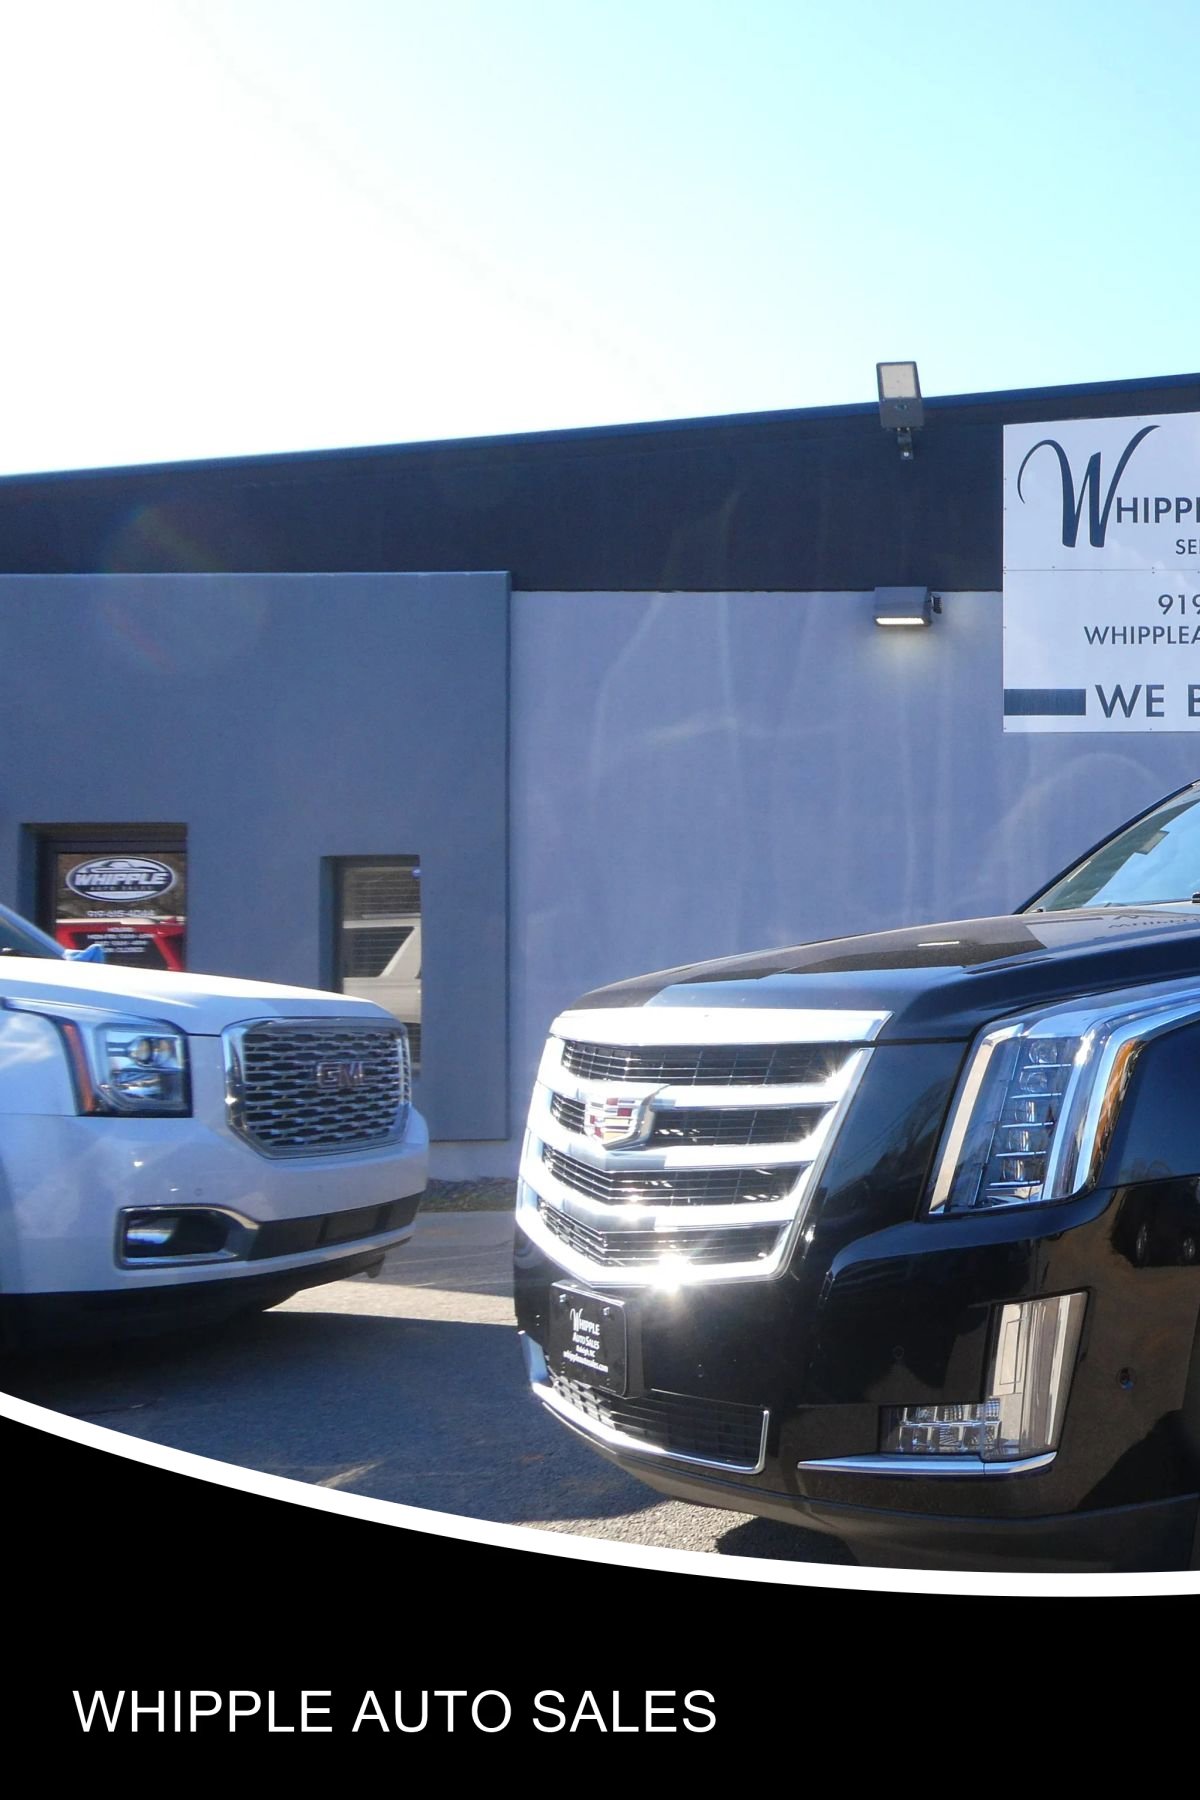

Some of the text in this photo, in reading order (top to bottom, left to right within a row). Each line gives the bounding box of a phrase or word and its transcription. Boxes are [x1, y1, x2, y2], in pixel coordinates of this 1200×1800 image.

[1095, 685, 1165, 718] WE
[74, 873, 169, 886] WHIPPLE
[570, 1308, 600, 1336] WHIPPLE
